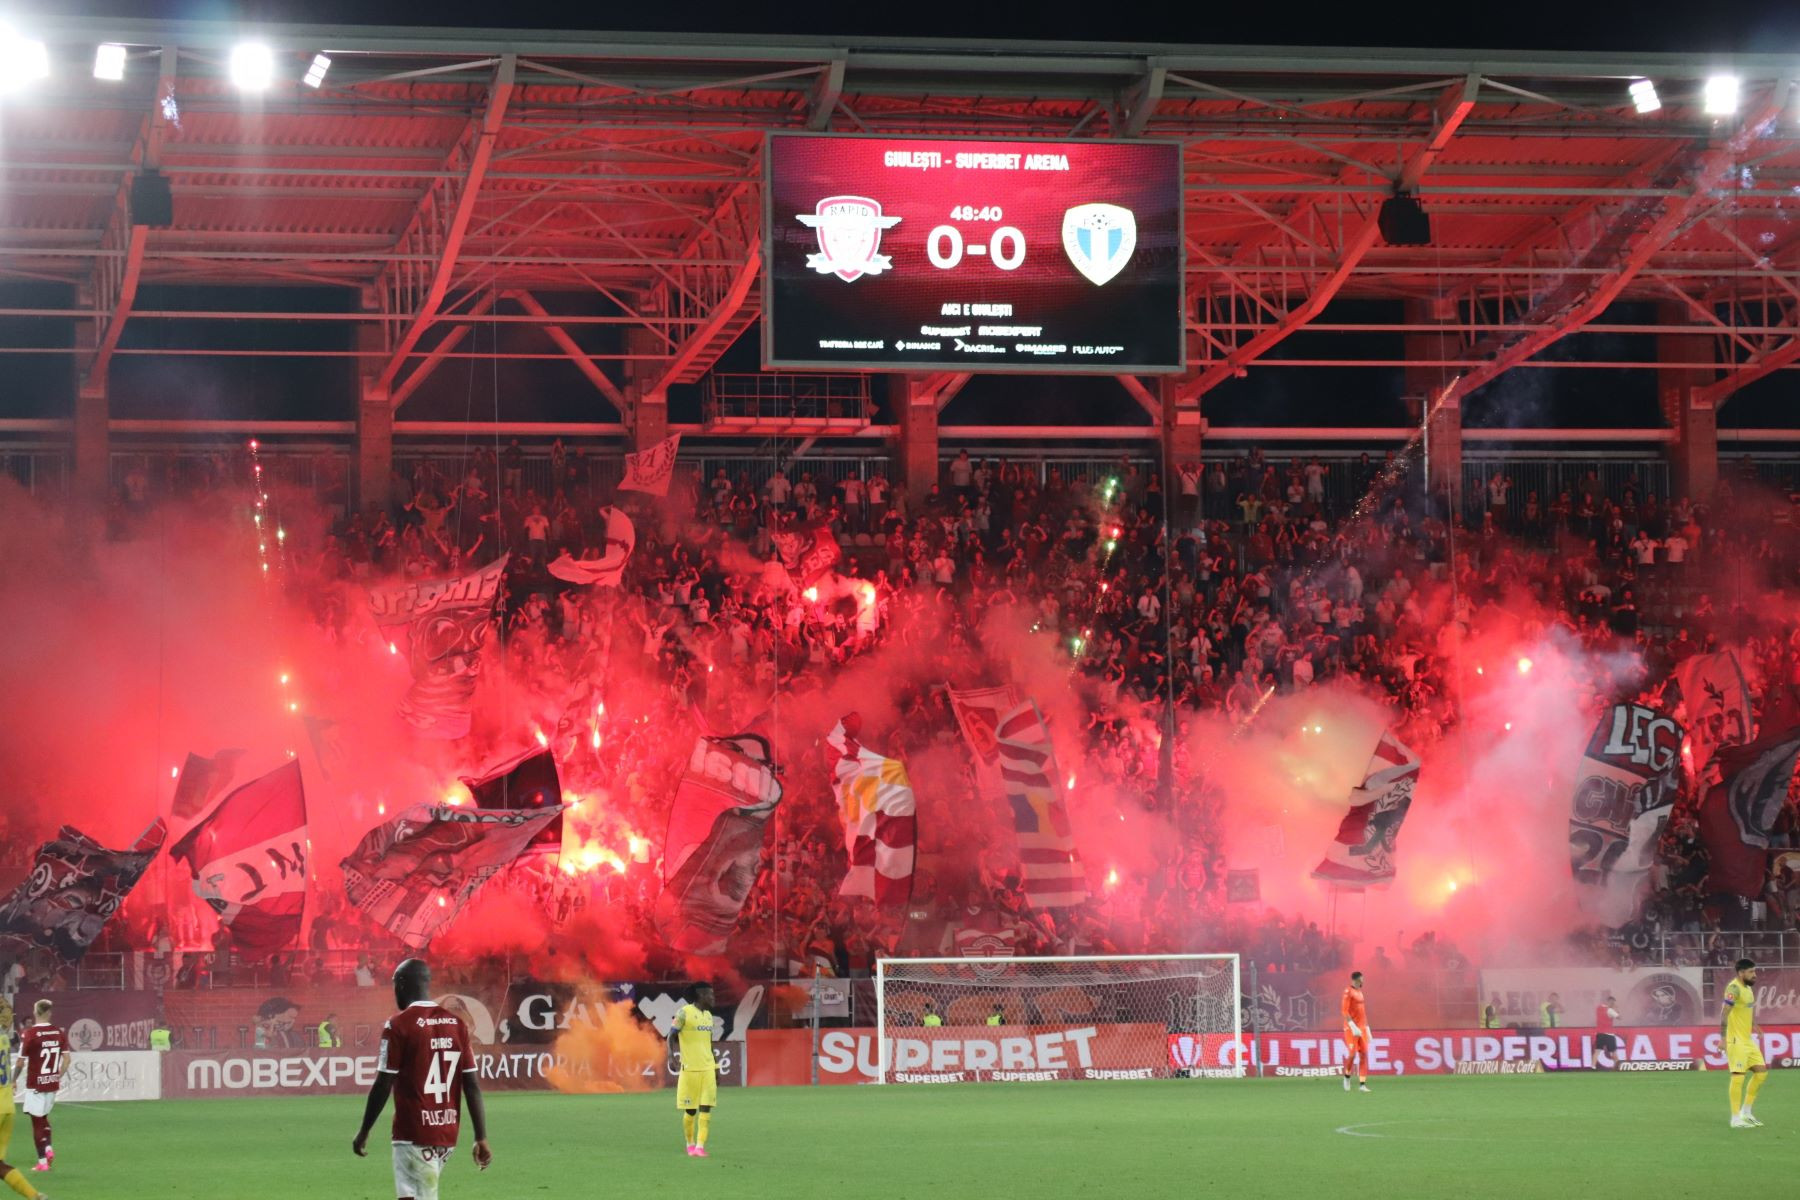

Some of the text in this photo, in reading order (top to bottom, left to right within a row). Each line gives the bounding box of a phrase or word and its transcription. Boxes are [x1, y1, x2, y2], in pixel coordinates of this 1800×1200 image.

[955, 153, 1022, 170] SUPERBET
[1024, 153, 1070, 171] ARENA
[830, 205, 869, 217] RAPID
[950, 205, 1003, 222] 48:40
[905, 342, 941, 350] BINANCE
[426, 1017, 458, 1026] BINANCE
[431, 1037, 453, 1049] CHRIS
[1669, 1034, 1692, 1061] E
[819, 1027, 1097, 1077] SUPERBET
[40, 1047, 61, 1075] 27
[1457, 1060, 1498, 1074] TRATTORIA
[1501, 1060, 1516, 1073] Roz
[1619, 1061, 1694, 1071] MOBEXPERT
[187, 1056, 377, 1089] MOBEXPE
[895, 1071, 965, 1083] SUPERBET
[992, 1070, 1059, 1081] SUPERBET
[1085, 1068, 1153, 1080] SUPERBET
[1275, 1065, 1345, 1077] SUPERBET
[424, 1051, 462, 1104] 47
